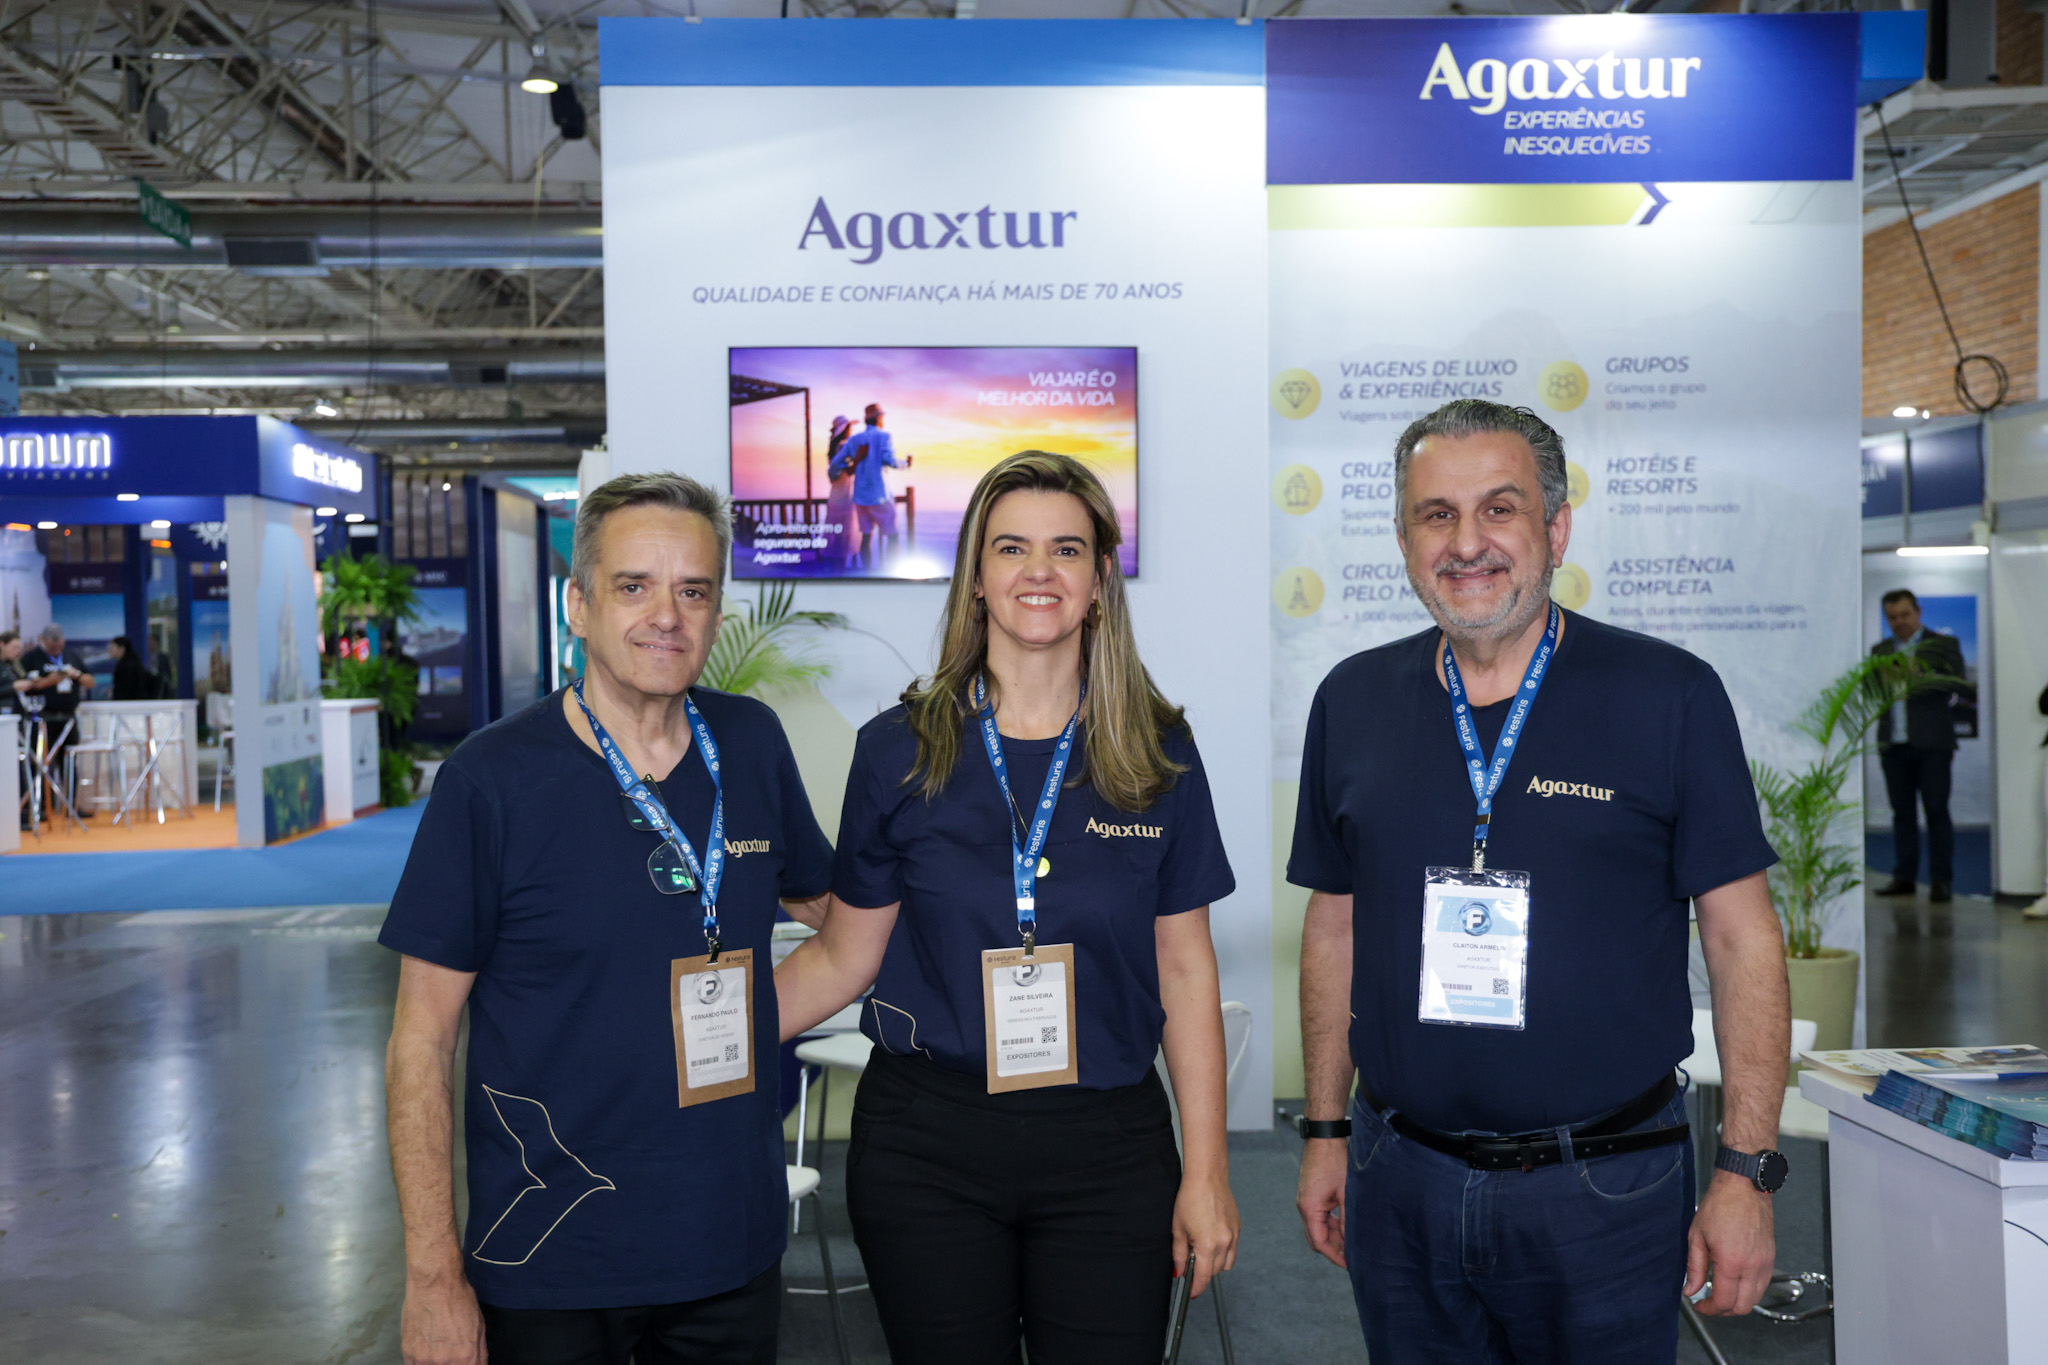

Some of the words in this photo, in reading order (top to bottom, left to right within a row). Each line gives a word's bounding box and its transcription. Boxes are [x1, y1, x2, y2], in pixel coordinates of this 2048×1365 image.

[1419, 42, 1702, 115] Agaxtur
[1503, 106, 1646, 129] EXPERIÊNCIAS
[1503, 132, 1652, 155] INESQUECÍVEIS
[797, 196, 1078, 265] Agaxtur
[692, 285, 815, 305] QUALIDADE
[821, 285, 834, 302] E
[839, 284, 961, 305] CONFIANÇA
[967, 280, 997, 301] HÁ
[1002, 283, 1055, 300] MAIS
[1060, 283, 1089, 300] DE
[1094, 283, 1118, 299] 70
[1122, 282, 1184, 299] ANOS
[1339, 360, 1427, 378] VIAGENS
[1432, 359, 1459, 377] DE
[1464, 359, 1517, 376] LUXO
[1605, 356, 1690, 374] GRUPOS
[1028, 371, 1086, 387] VIAJAR
[1086, 368, 1100, 387] É
[1100, 371, 1116, 387] O
[977, 390, 1048, 407] MELHOR
[1049, 390, 1074, 406] DA
[1075, 390, 1116, 406] VIDA
[1339, 382, 1353, 400] &
[1359, 379, 1503, 399] EXPERIÊNCIAS
[1338, 409, 1387, 425] Viagens
[1390, 410, 1413, 421] sob
[0, 433, 111, 469] mum
[1340, 462, 1395, 479] CRUZ
[1605, 452, 1679, 474] HOTÉIS
[1684, 456, 1698, 473] E
[1341, 483, 1393, 500] PELO
[1606, 477, 1699, 495] RESORTS
[1607, 554, 1736, 576] ASSISTÊNCIA
[1343, 584, 1394, 601] PELO
[1607, 579, 1713, 597] COMPLETA
[1531, 645, 1551, 678] Festuris
[1447, 665, 1461, 697] Festuris
[1507, 699, 1529, 735] Festuris
[697, 723, 717, 760] Festuris
[985, 718, 1000, 755] Festuris
[1458, 714, 1475, 751] Festuris
[607, 748, 633, 784] Festuris
[1486, 757, 1506, 795] Festuris
[1046, 760, 1063, 798] Festuris
[1526, 775, 1615, 801] Agaxtur
[1028, 819, 1047, 856] Festuris
[1085, 816, 1164, 839] Agaxtur
[724, 838, 771, 858] Agaxtur
[1009, 994, 1026, 1002] ZANE
[1026, 992, 1054, 1001] SILVEIRA
[690, 1011, 720, 1021] FERNANDO
[720, 1007, 738, 1016] PAULO
[1006, 1050, 1051, 1060] EXPOSITORES
